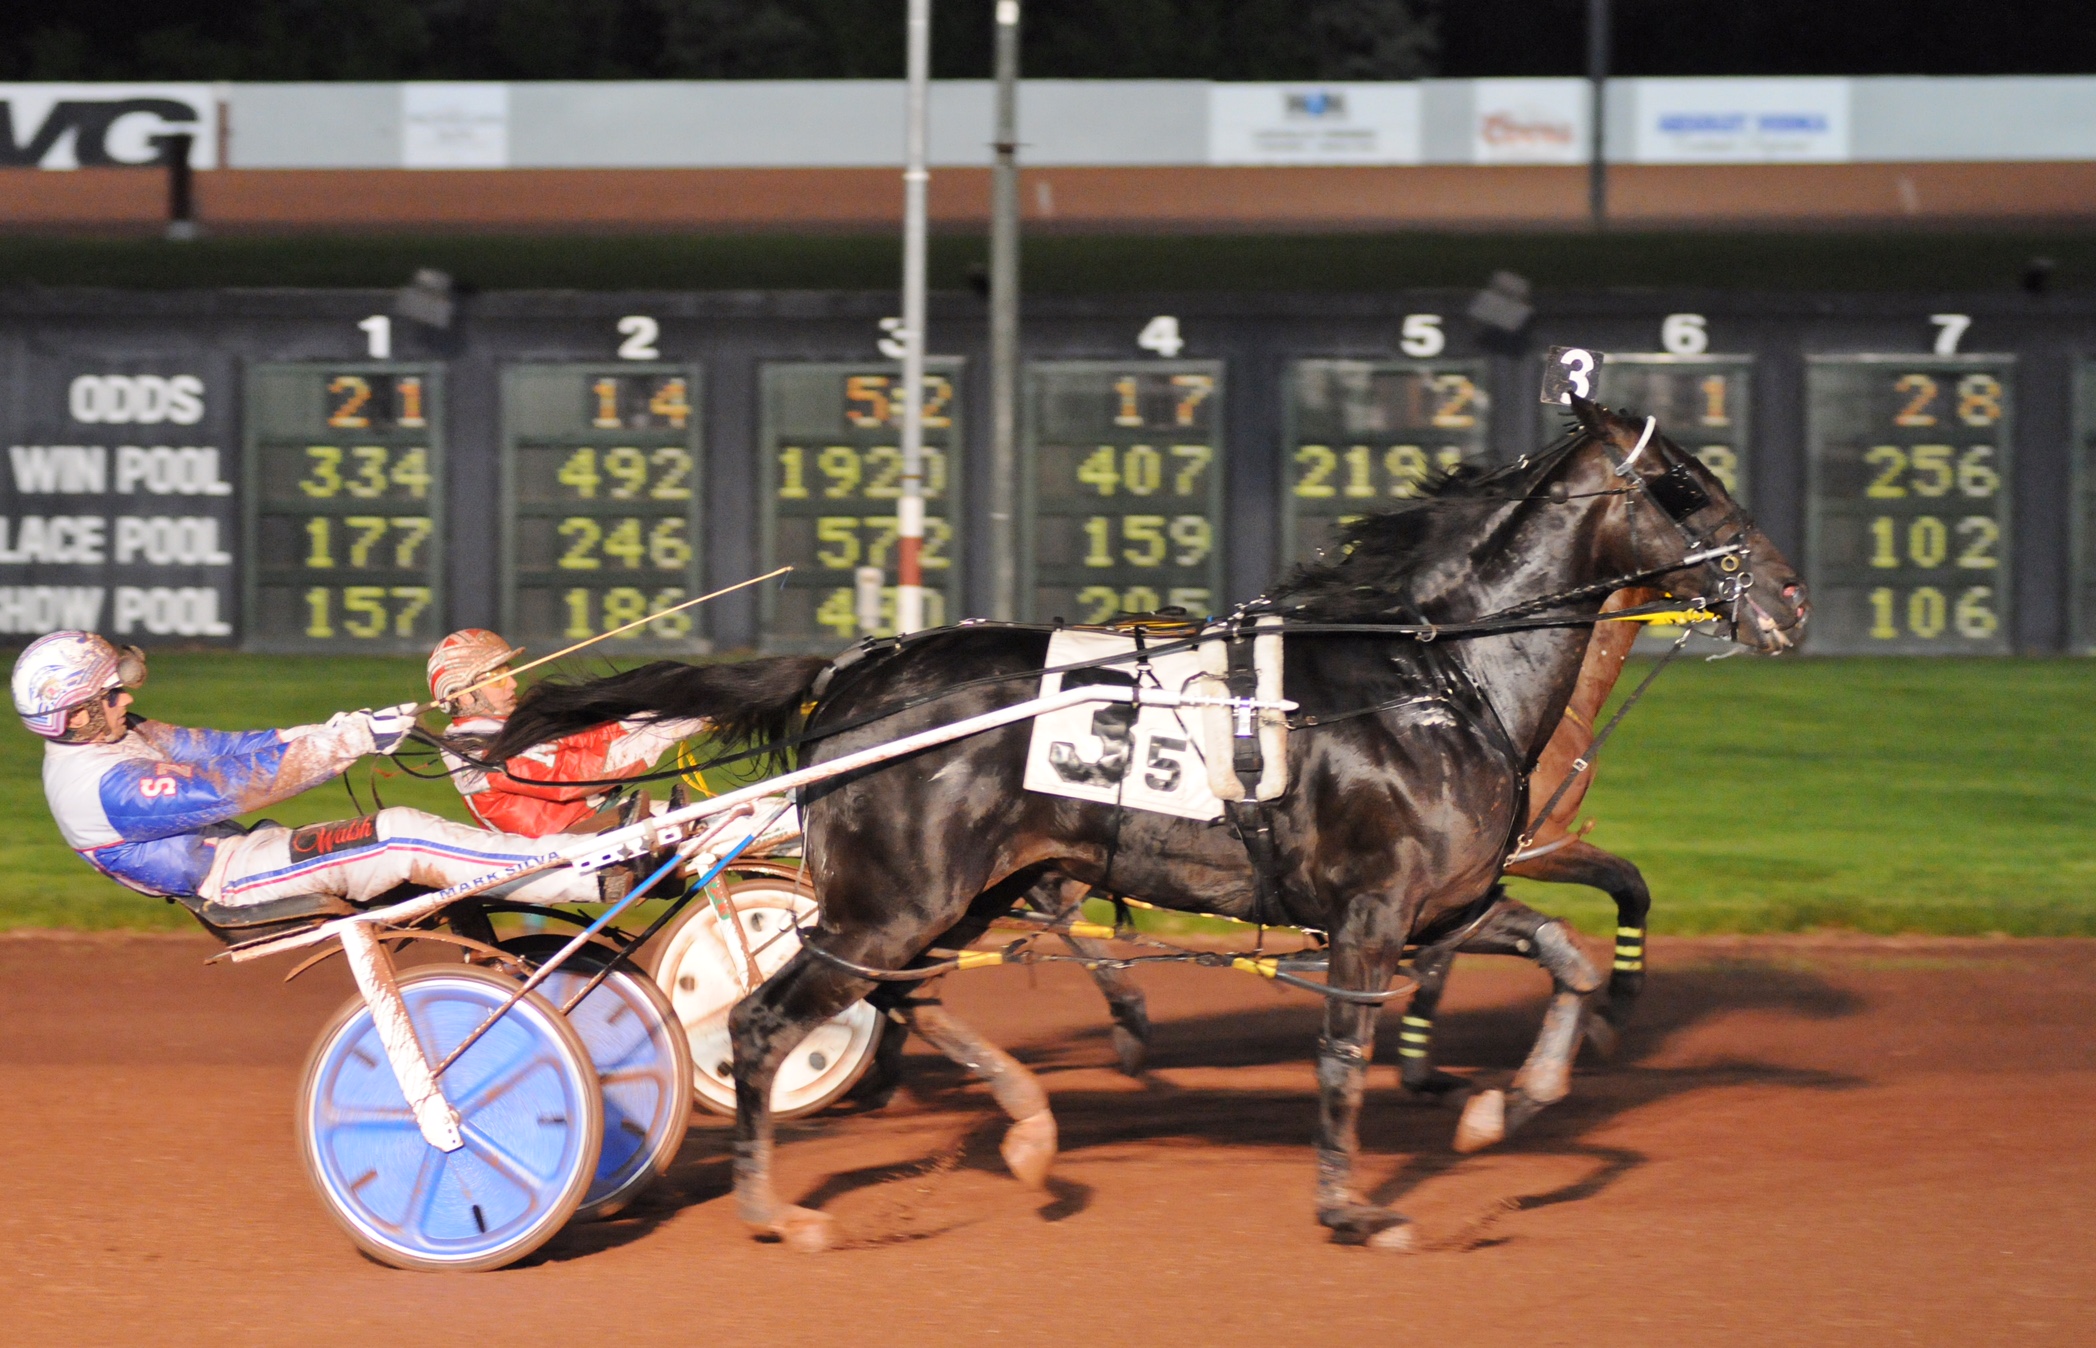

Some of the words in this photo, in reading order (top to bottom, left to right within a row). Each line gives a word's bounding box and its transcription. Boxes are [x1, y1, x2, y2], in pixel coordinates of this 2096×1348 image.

[358, 315, 391, 359] 1
[617, 315, 660, 360] 2
[1137, 315, 1184, 357] 4
[1400, 314, 1445, 357] 5
[1662, 313, 1708, 355] 6
[1930, 313, 1972, 356] 7
[69, 375, 204, 424] ODDS
[1560, 348, 1594, 404] 3
[1701, 375, 1730, 427] 1
[10, 446, 106, 493] WIN
[116, 446, 232, 495] POOL
[300, 446, 431, 498] 334
[558, 447, 693, 499] 492
[1077, 444, 1213, 496] 407
[1865, 445, 1998, 498] 256
[114, 516, 232, 565] POOL
[306, 517, 432, 569] 177
[558, 517, 692, 570] 246
[817, 516, 953, 569] 572
[1084, 514, 1212, 567] 159
[1869, 515, 1999, 569] 102
[113, 587, 232, 636] POOL
[306, 587, 432, 638] 157
[565, 588, 693, 640] 186
[1869, 586, 1998, 639] 106
[1145, 734, 1189, 793] 5
[293, 817, 373, 854] Walsh
[439, 871, 499, 899] MARK
[504, 850, 561, 874] SILVA
